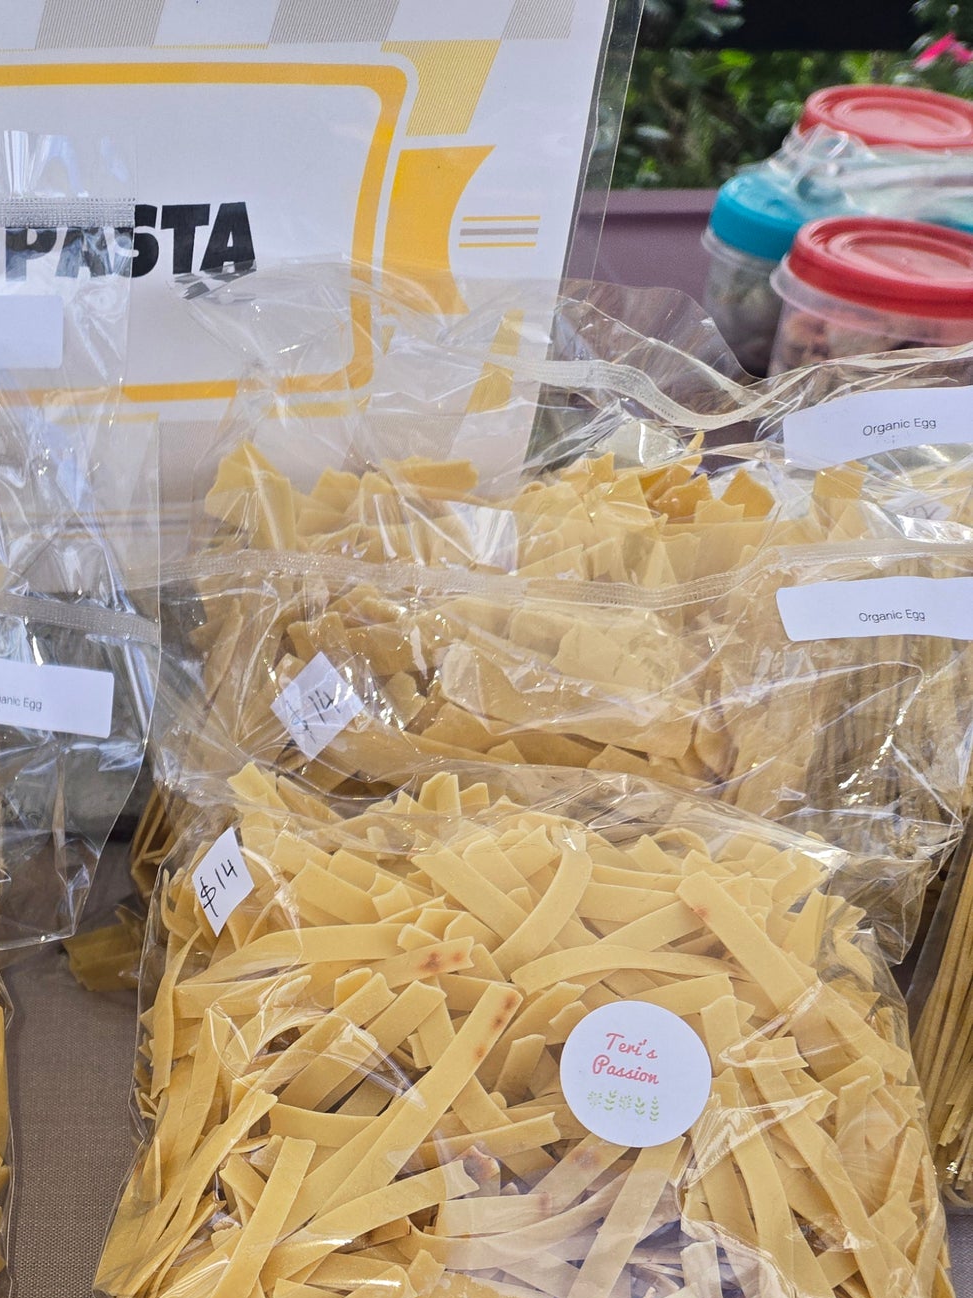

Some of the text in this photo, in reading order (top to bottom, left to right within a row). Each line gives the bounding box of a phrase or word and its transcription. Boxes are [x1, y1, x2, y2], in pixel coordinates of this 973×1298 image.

[4, 202, 257, 284] PASTA
[862, 417, 937, 437] Organic Egg
[858, 609, 926, 624] Organic Egg
[22, 696, 43, 712] Egg
[200, 858, 238, 917] $14
[605, 1032, 659, 1059] Teri's
[592, 1054, 660, 1085] Passion
